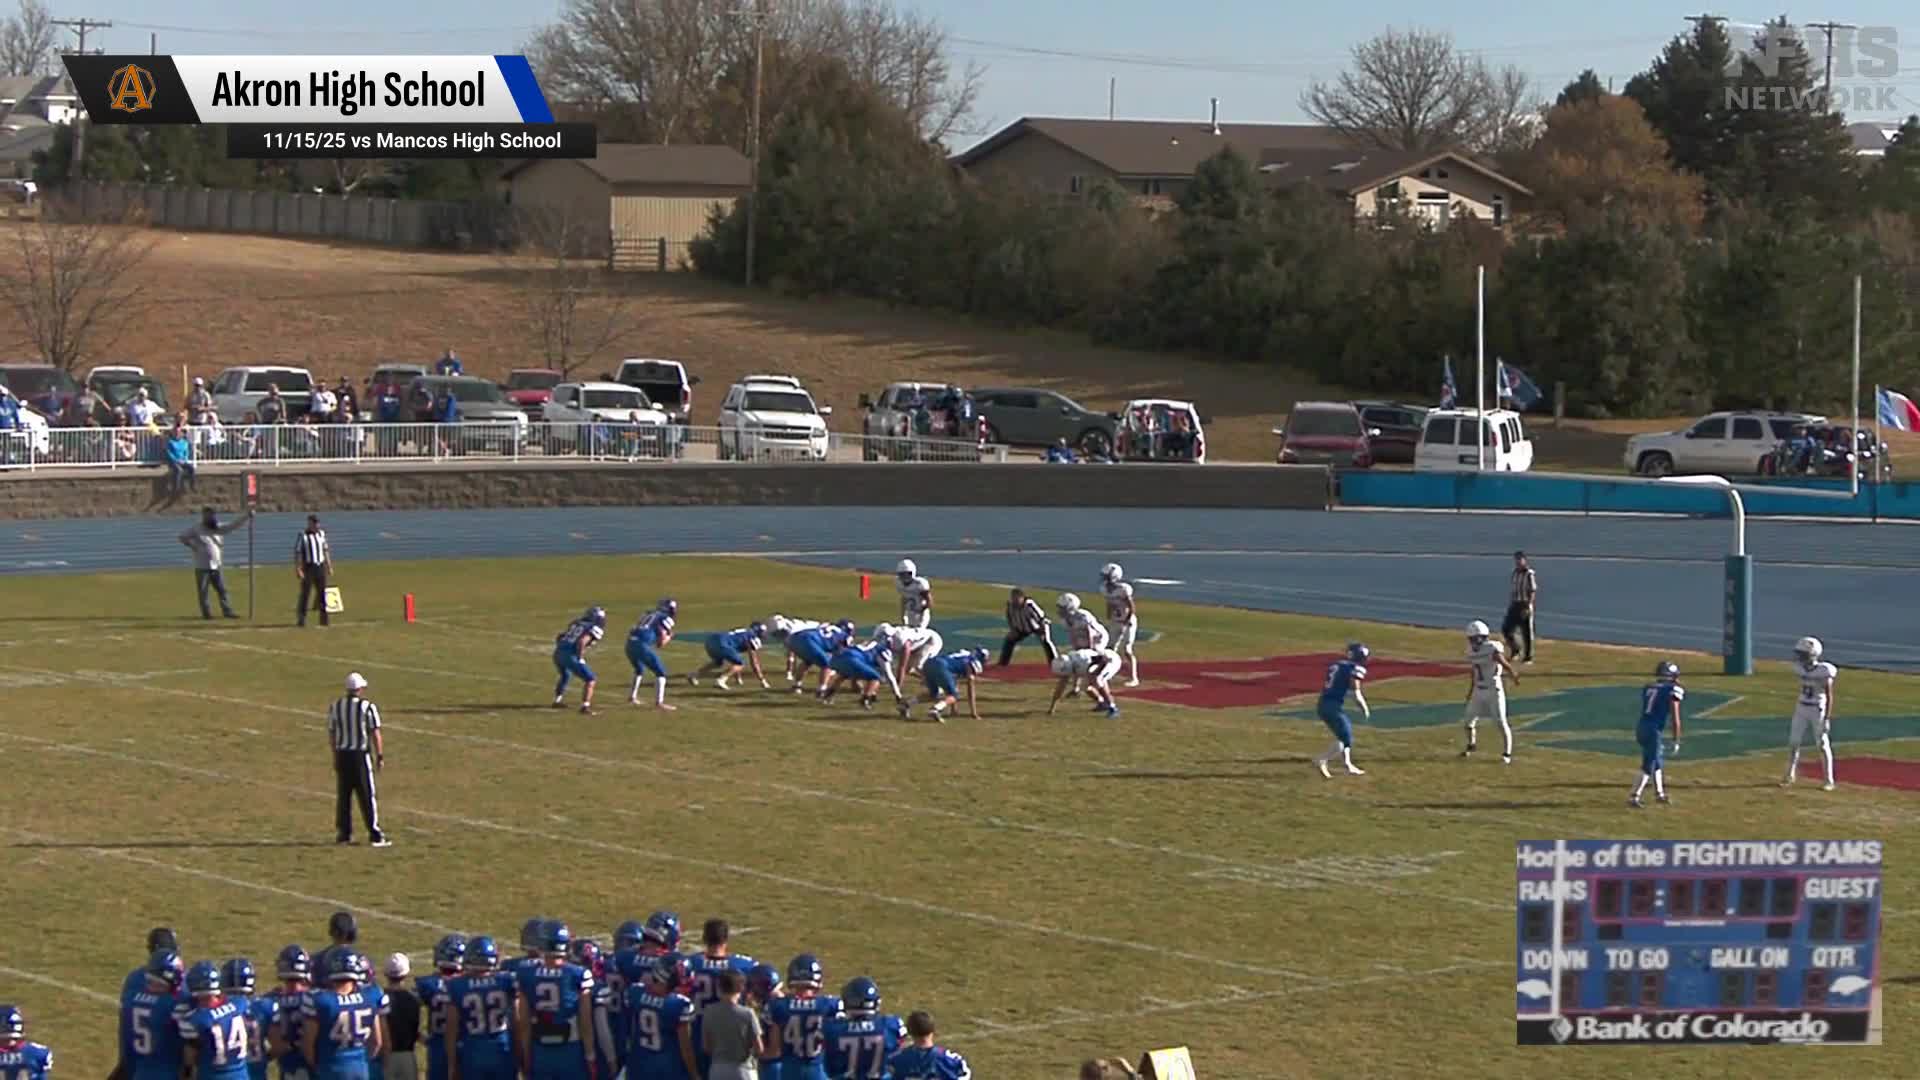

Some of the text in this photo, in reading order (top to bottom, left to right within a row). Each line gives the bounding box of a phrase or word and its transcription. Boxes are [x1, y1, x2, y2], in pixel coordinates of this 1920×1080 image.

[1592, 844, 1622, 867] of
[1625, 844, 1667, 867] the
[1672, 842, 1798, 866] FIGHTING
[1803, 841, 1882, 865] RAMS
[1804, 877, 1880, 899] GUEST
[1605, 948, 1670, 970] TO GO
[1759, 948, 1790, 969] ON
[132, 1007, 152, 1054] 5
[329, 1008, 373, 1050] 45
[463, 990, 508, 1034] 32
[639, 1008, 663, 1051] 9
[1576, 1012, 1830, 1040] Bank of Colorado
[211, 1015, 248, 1065] 14
[784, 1015, 824, 1058] 42
[838, 1035, 885, 1080] 77
